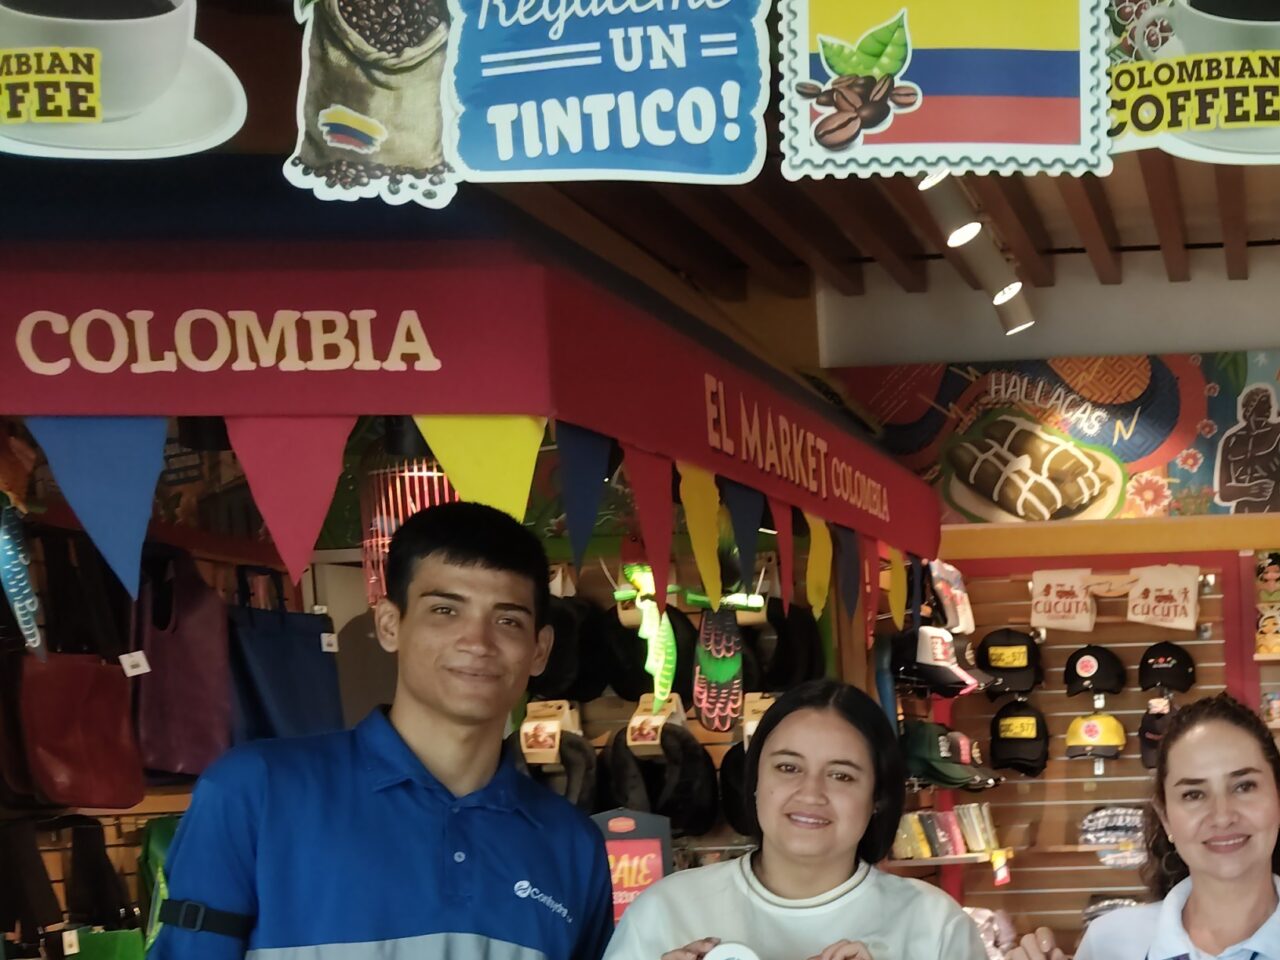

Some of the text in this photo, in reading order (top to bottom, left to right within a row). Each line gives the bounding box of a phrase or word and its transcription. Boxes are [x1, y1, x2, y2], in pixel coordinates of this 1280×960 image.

[608, 24, 687, 72] UN
[1110, 56, 1280, 91] OLOMBIAN
[486, 80, 740, 160] TINTICO!
[15, 309, 442, 376] COLOMBIA
[989, 370, 1110, 437] HALLACAS
[704, 373, 890, 522] EL MARKET COLOMBIA
